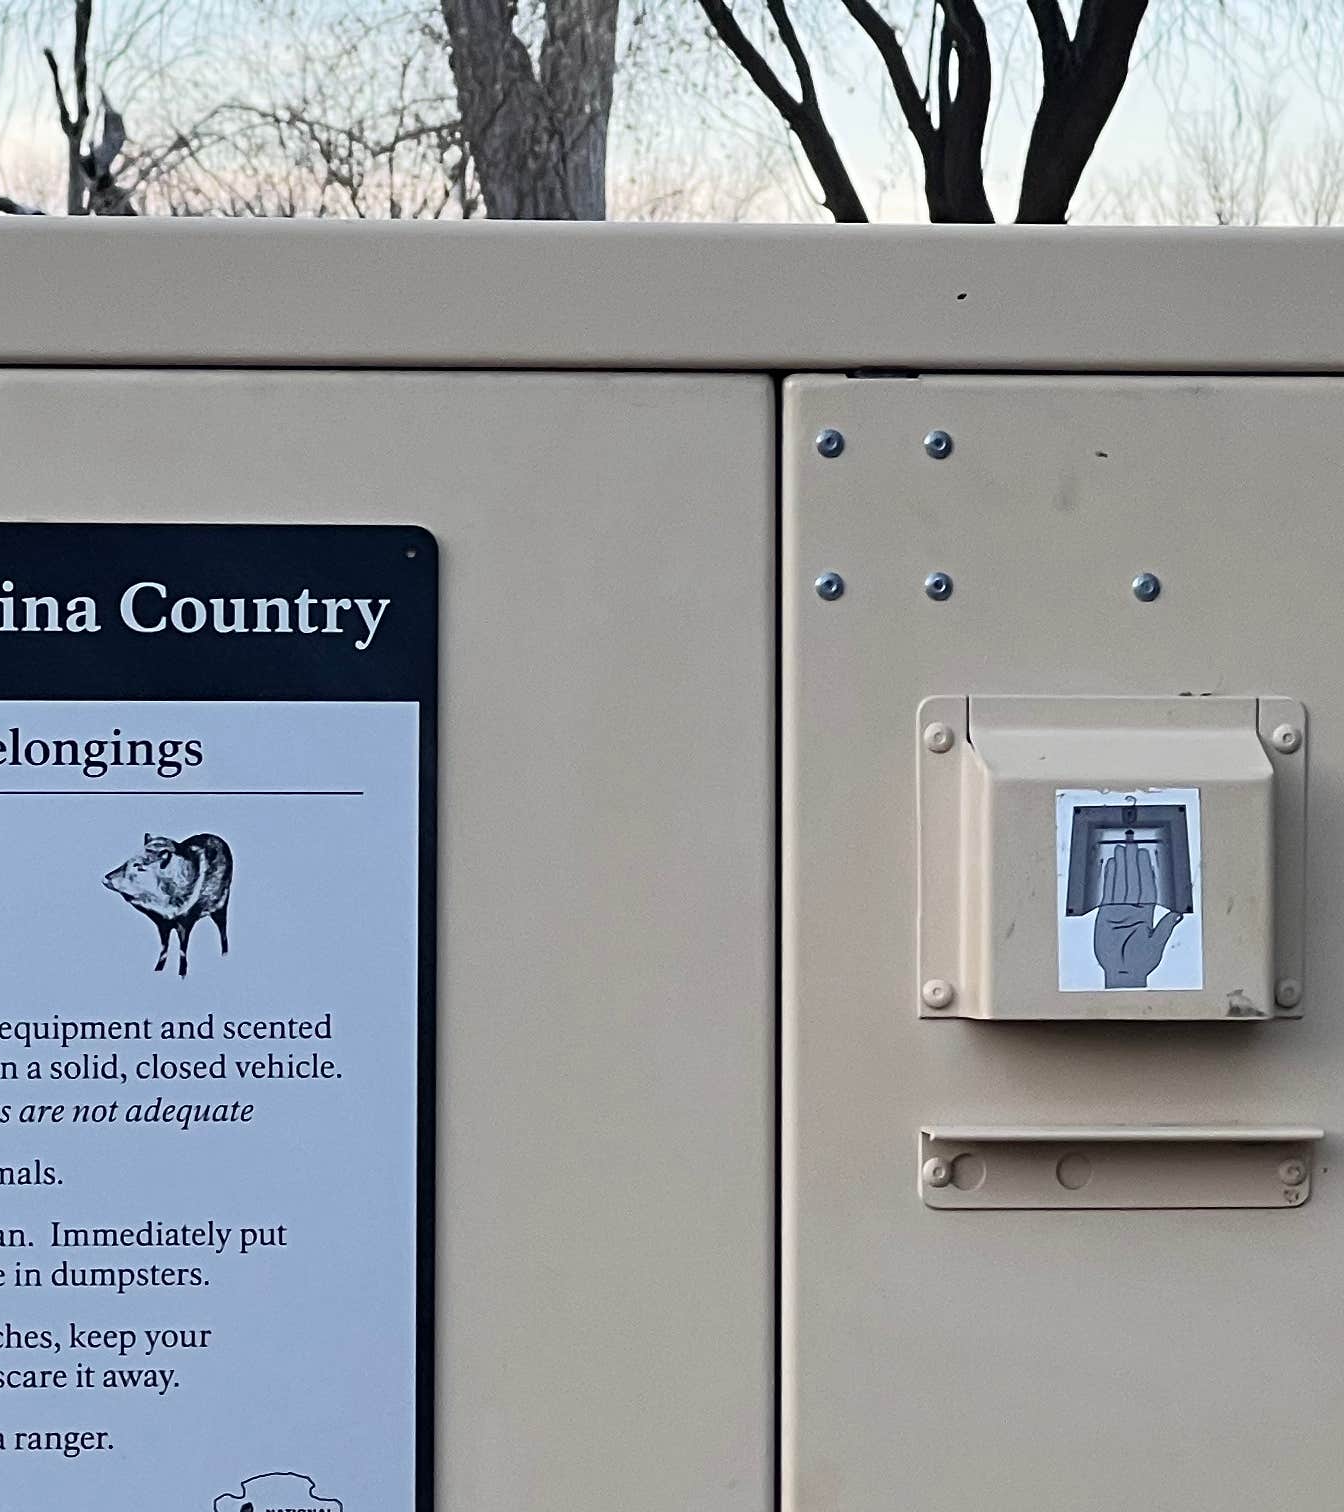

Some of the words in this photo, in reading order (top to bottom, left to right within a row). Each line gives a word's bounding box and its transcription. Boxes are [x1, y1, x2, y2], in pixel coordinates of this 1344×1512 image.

[120, 582, 390, 650] Country
[161, 1014, 214, 1039] and
[224, 1014, 331, 1039] scented
[27, 1062, 41, 1079] a
[50, 1054, 126, 1083] solid,
[136, 1054, 226, 1079] closed
[235, 1053, 341, 1078] vehicle.
[19, 1105, 64, 1122] are
[73, 1101, 118, 1122] not
[126, 1097, 253, 1130] adequate
[51, 1221, 231, 1253] Immediately
[240, 1225, 287, 1253] put
[15, 1262, 42, 1286] in
[52, 1261, 209, 1294] dumpsters.
[70, 1323, 136, 1356] keep
[144, 1330, 212, 1355] your
[76, 1363, 95, 1387] it
[103, 1370, 179, 1395] away.
[15, 1432, 113, 1457] ranger.
